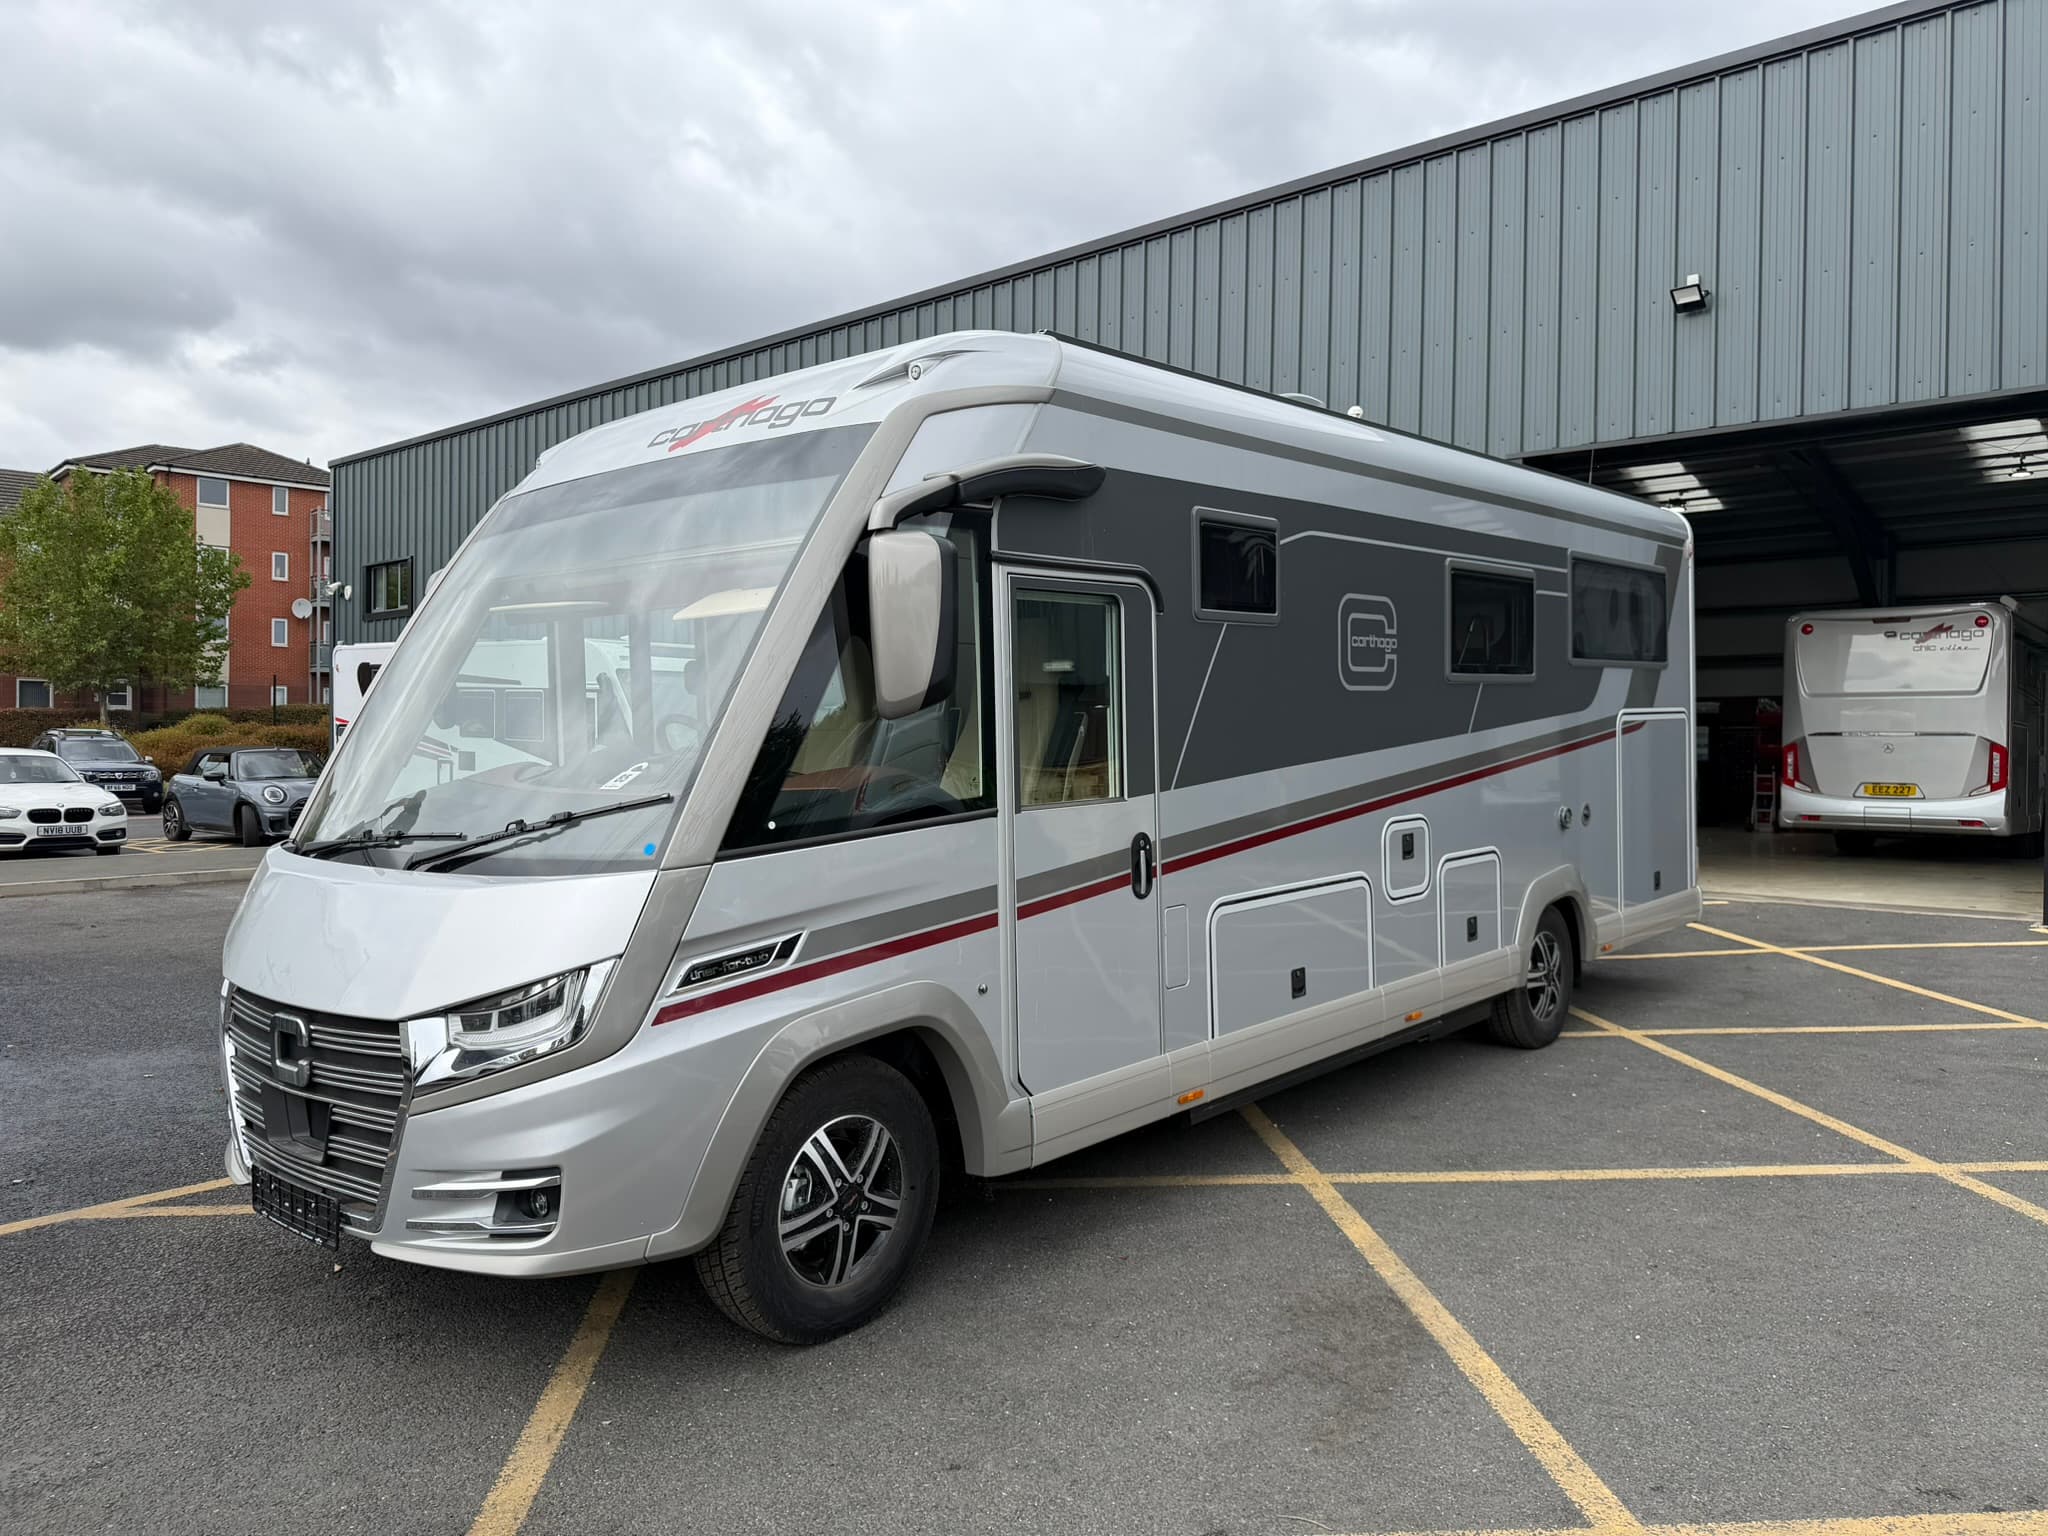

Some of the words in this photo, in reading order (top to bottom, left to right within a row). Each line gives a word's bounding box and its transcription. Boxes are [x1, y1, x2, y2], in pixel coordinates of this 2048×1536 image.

[648, 396, 837, 449] carthago
[1351, 634, 1398, 653] carthago
[1893, 785, 1911, 795] 227
[43, 827, 63, 835] NV18
